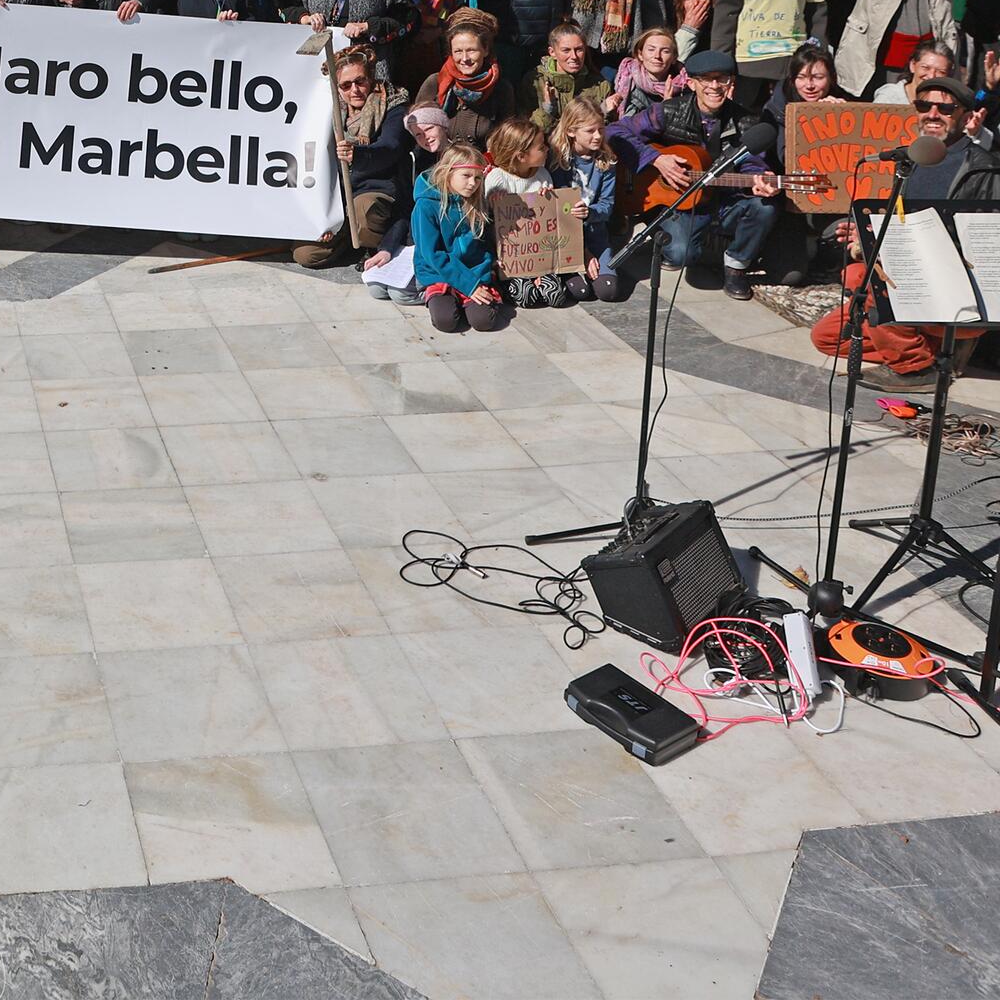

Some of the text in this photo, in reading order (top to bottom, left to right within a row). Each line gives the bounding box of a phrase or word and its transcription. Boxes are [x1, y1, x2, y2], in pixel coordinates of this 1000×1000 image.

[127, 53, 298, 124] bello,
[862, 111, 919, 146] NOS
[19, 121, 317, 189] Marbella!
[546, 218, 558, 232] ES
[500, 242, 539, 258] FUTURO
